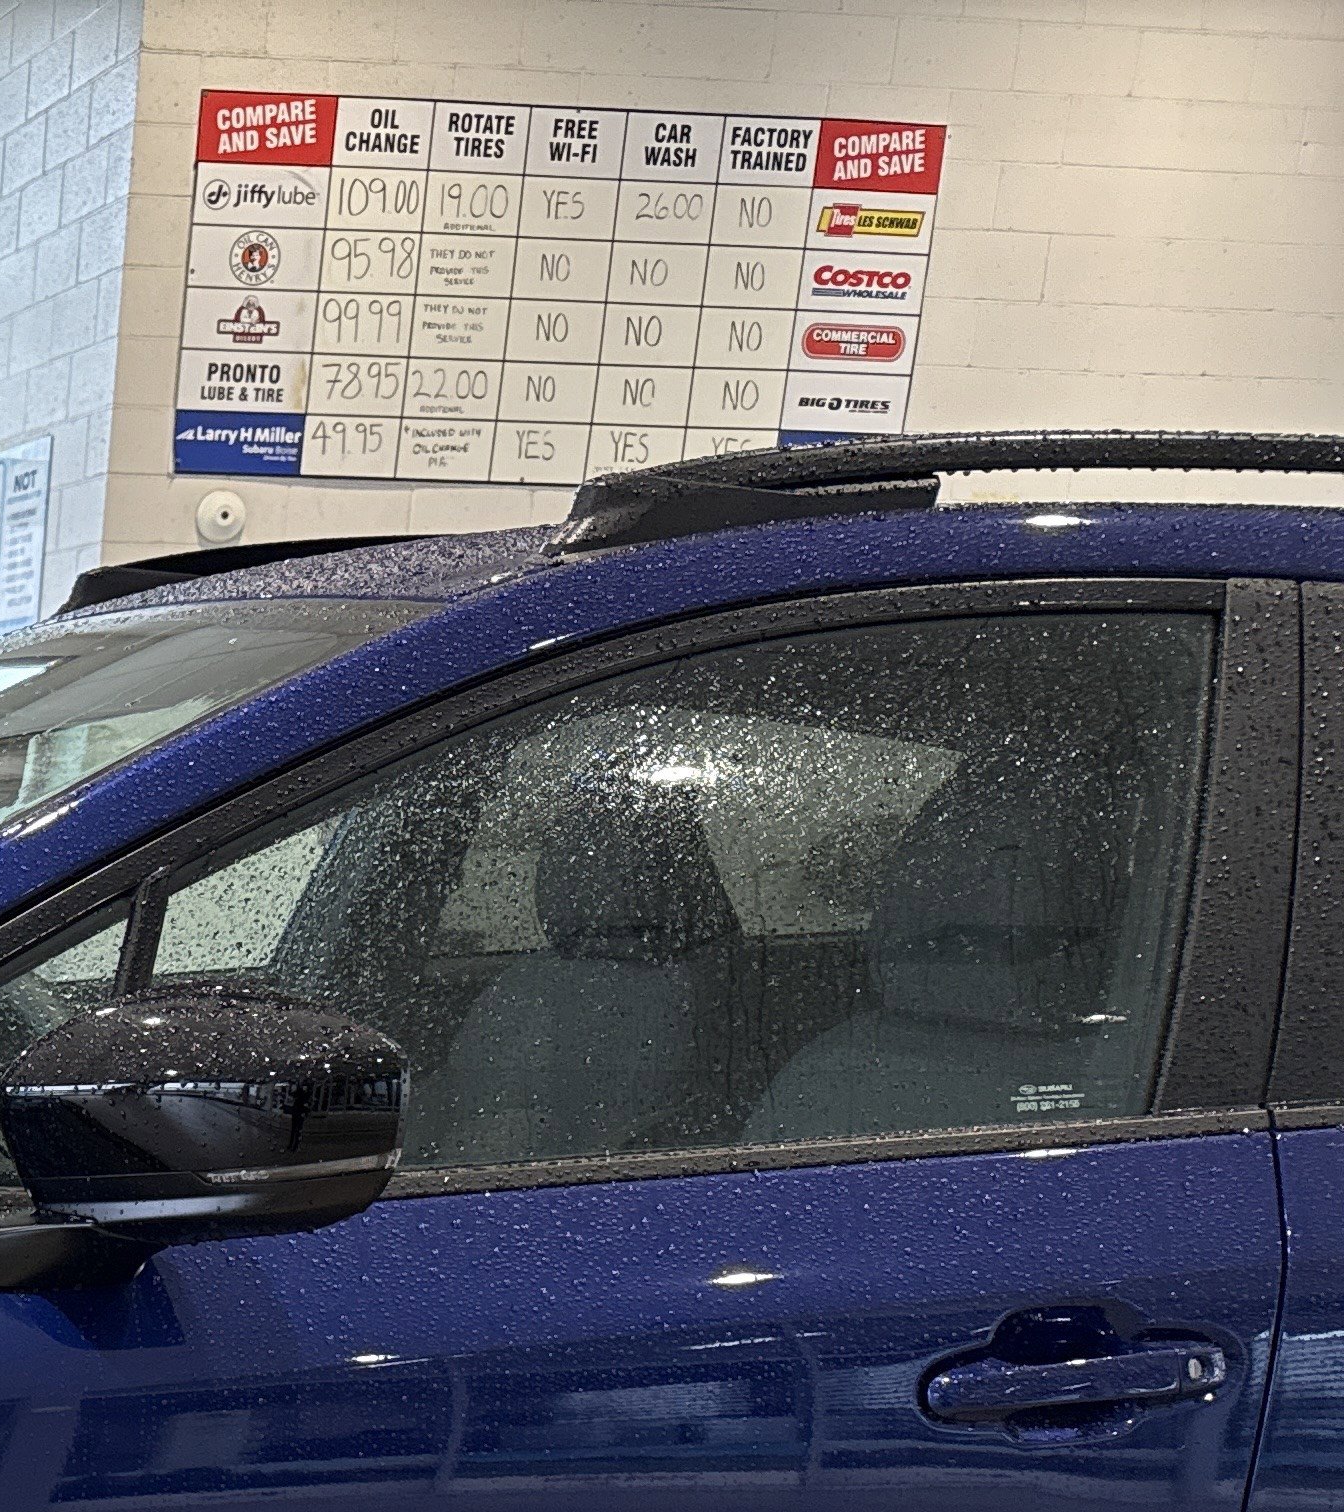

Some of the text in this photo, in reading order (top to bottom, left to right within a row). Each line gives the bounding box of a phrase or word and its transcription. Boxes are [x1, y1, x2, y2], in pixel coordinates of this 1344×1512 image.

[216, 99, 317, 131] COMPARE
[370, 108, 400, 129] OIL
[447, 112, 516, 136] ROTATE
[217, 122, 317, 155] AND SAVE
[552, 118, 599, 140] FREE
[654, 122, 692, 144] CAR
[730, 126, 813, 150] FACTORY
[344, 131, 421, 154] CHANGE
[453, 137, 505, 159] TIRES
[549, 142, 598, 164] WI-FI
[833, 129, 927, 158] COMPARE
[644, 146, 698, 168] WASH
[730, 150, 808, 173] TRAINED
[833, 151, 926, 182] AND SAVE
[542, 189, 586, 220] YES
[738, 196, 773, 228] NO
[830, 208, 857, 228] Tires
[857, 214, 919, 230] LES SCHWAB
[236, 232, 276, 251] OIL CAN
[429, 248, 496, 259] THEY DO NOT
[233, 262, 276, 283] HENRY'S
[539, 253, 571, 282] NO
[629, 258, 668, 287] NO
[734, 261, 765, 292] NO
[813, 264, 912, 290] COSTCO
[842, 288, 908, 300] WHOLESALE
[423, 303, 449, 314] THEY
[467, 306, 488, 316] NOT
[535, 311, 569, 343] NO
[624, 315, 663, 347] NO
[728, 320, 763, 352] NO
[812, 328, 897, 345] COMMERCIAL
[838, 342, 868, 355] TIRE
[207, 362, 281, 385] PRONTO
[200, 386, 284, 403] LUBE & TIRE
[525, 375, 556, 403] NO
[722, 379, 759, 411] NO
[798, 396, 825, 409] BIG
[844, 398, 891, 411] TIRES
[196, 426, 302, 446] Larry H Miller
[312, 420, 384, 456] 49.95
[515, 429, 555, 461] YES
[610, 430, 649, 464] YES
